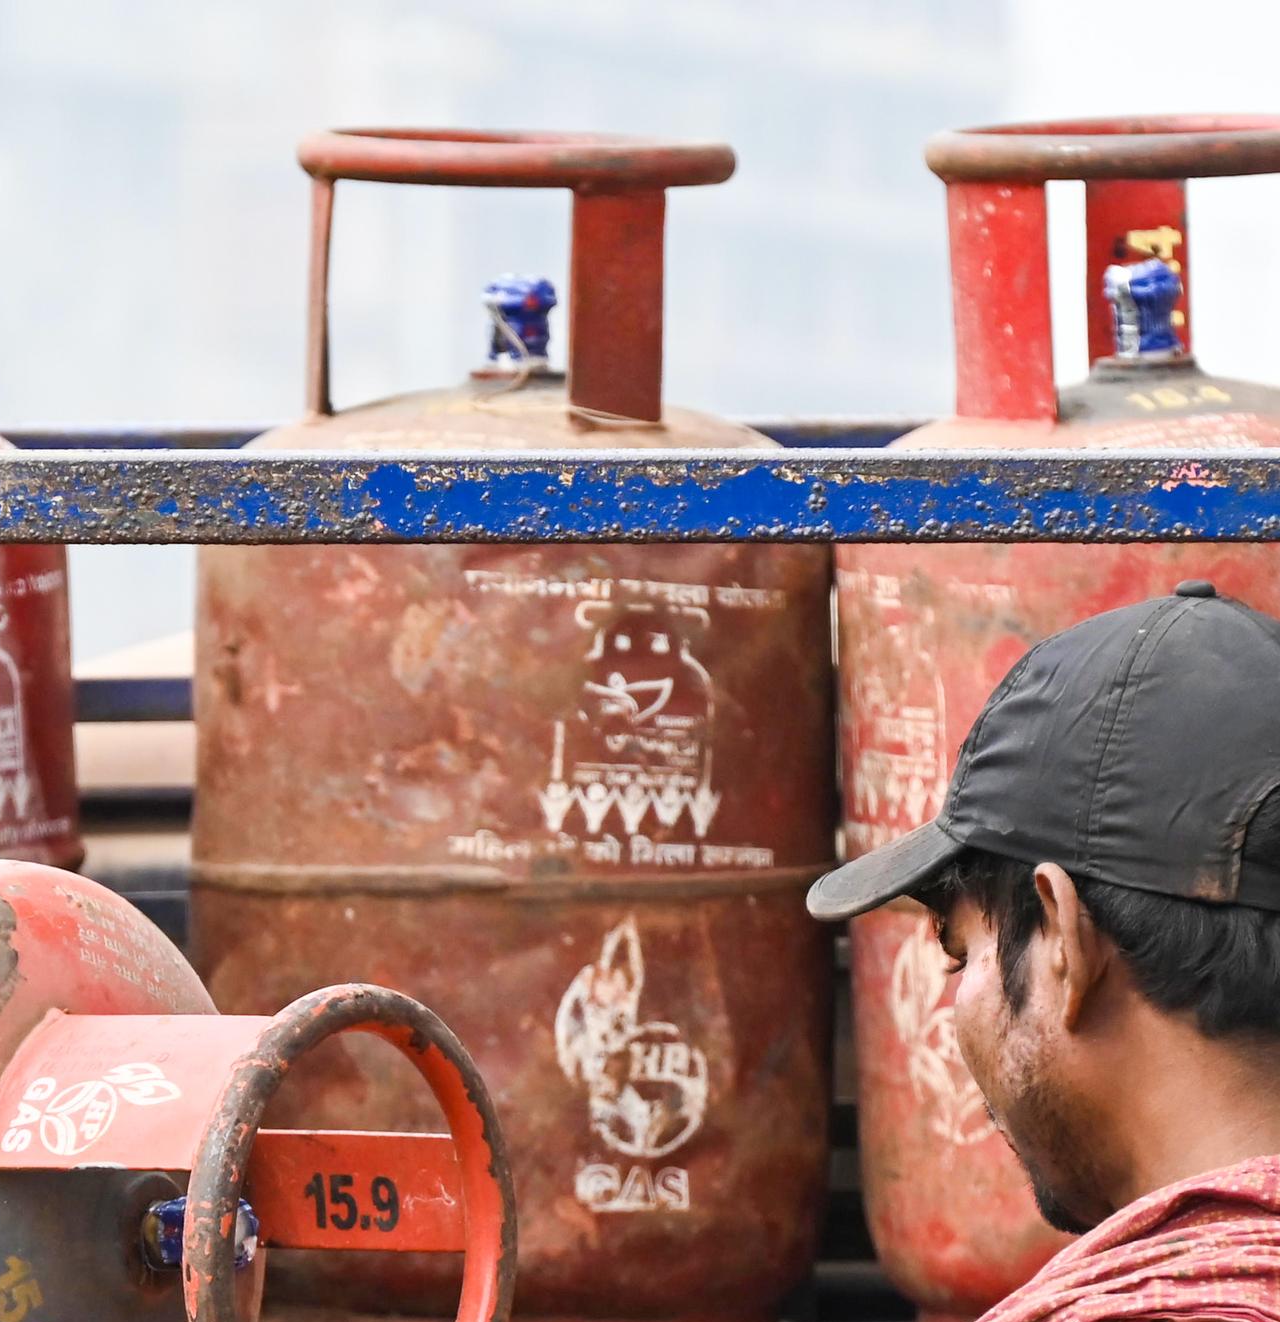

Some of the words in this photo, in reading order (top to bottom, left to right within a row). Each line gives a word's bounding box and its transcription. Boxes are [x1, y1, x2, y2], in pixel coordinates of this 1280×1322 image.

[1, 1077, 56, 1153] GAS
[80, 1099, 110, 1140] HP
[304, 1173, 400, 1233] 15.9
[575, 1164, 690, 1213] GAS
